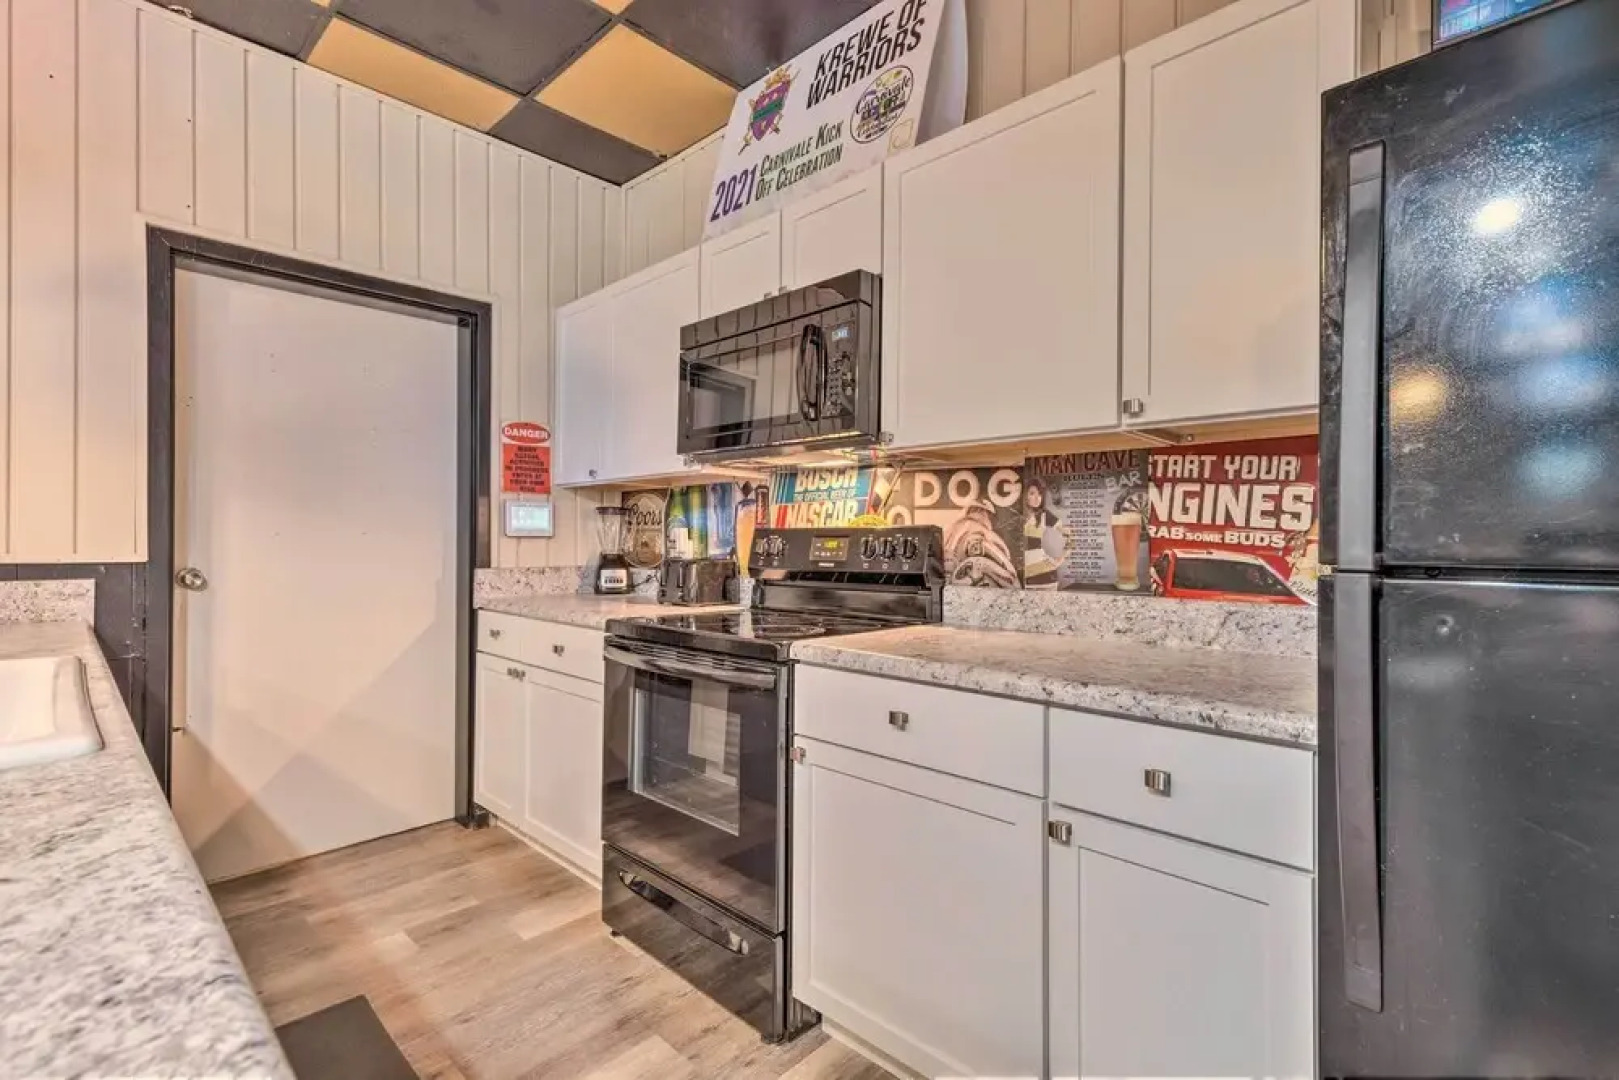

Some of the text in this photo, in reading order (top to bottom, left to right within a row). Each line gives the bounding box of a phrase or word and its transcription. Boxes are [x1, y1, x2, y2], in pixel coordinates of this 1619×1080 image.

[814, 0, 926, 81] KREWE OF
[806, 18, 925, 110] WARRIORS
[755, 143, 844, 201] OFF CELEBRATION
[710, 163, 758, 222] 2021
[504, 426, 548, 440] DANGER
[1034, 450, 1140, 475] MAN CAVE
[1148, 455, 1298, 480] TART YOUR
[914, 468, 1022, 508] DOG
[1105, 471, 1142, 492] BAR
[787, 499, 857, 528] NASCAR
[1148, 481, 1315, 531] NGINES
[1148, 526, 1286, 548] RAB SOME BUDS
